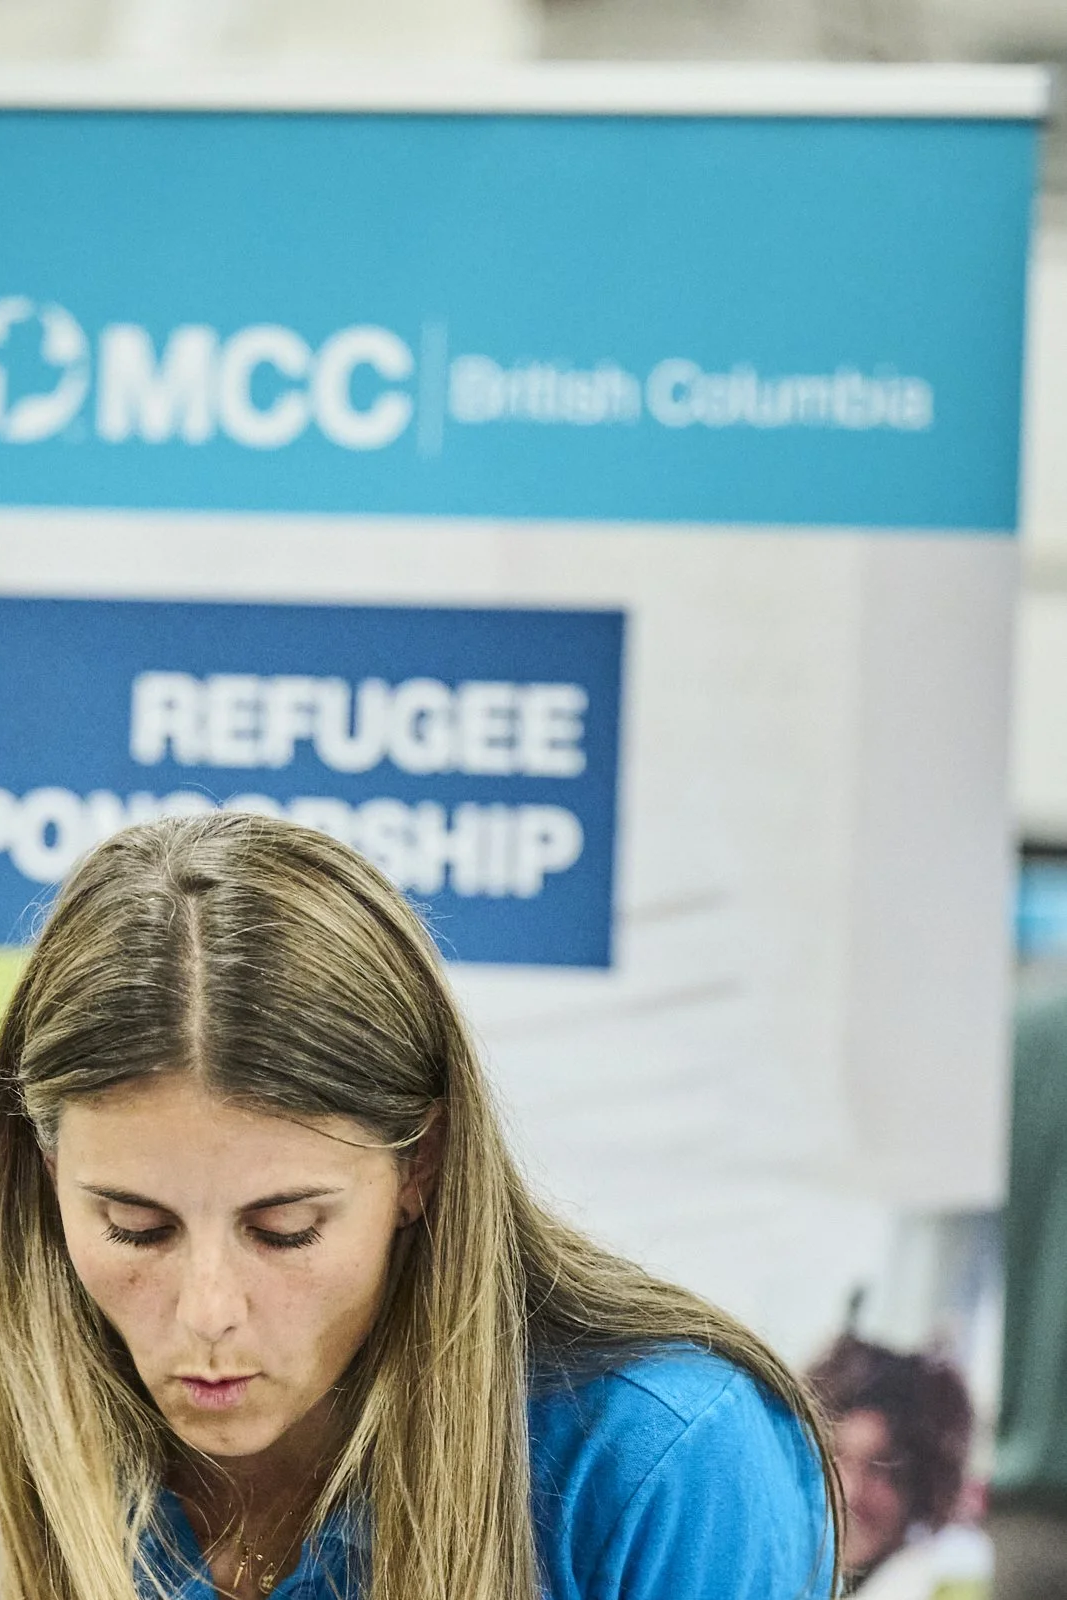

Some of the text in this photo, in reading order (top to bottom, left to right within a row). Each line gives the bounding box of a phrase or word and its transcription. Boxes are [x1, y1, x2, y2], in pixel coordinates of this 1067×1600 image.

[94, 321, 933, 451] MCC British Columbia
[129, 669, 590, 778] REFUGEE
